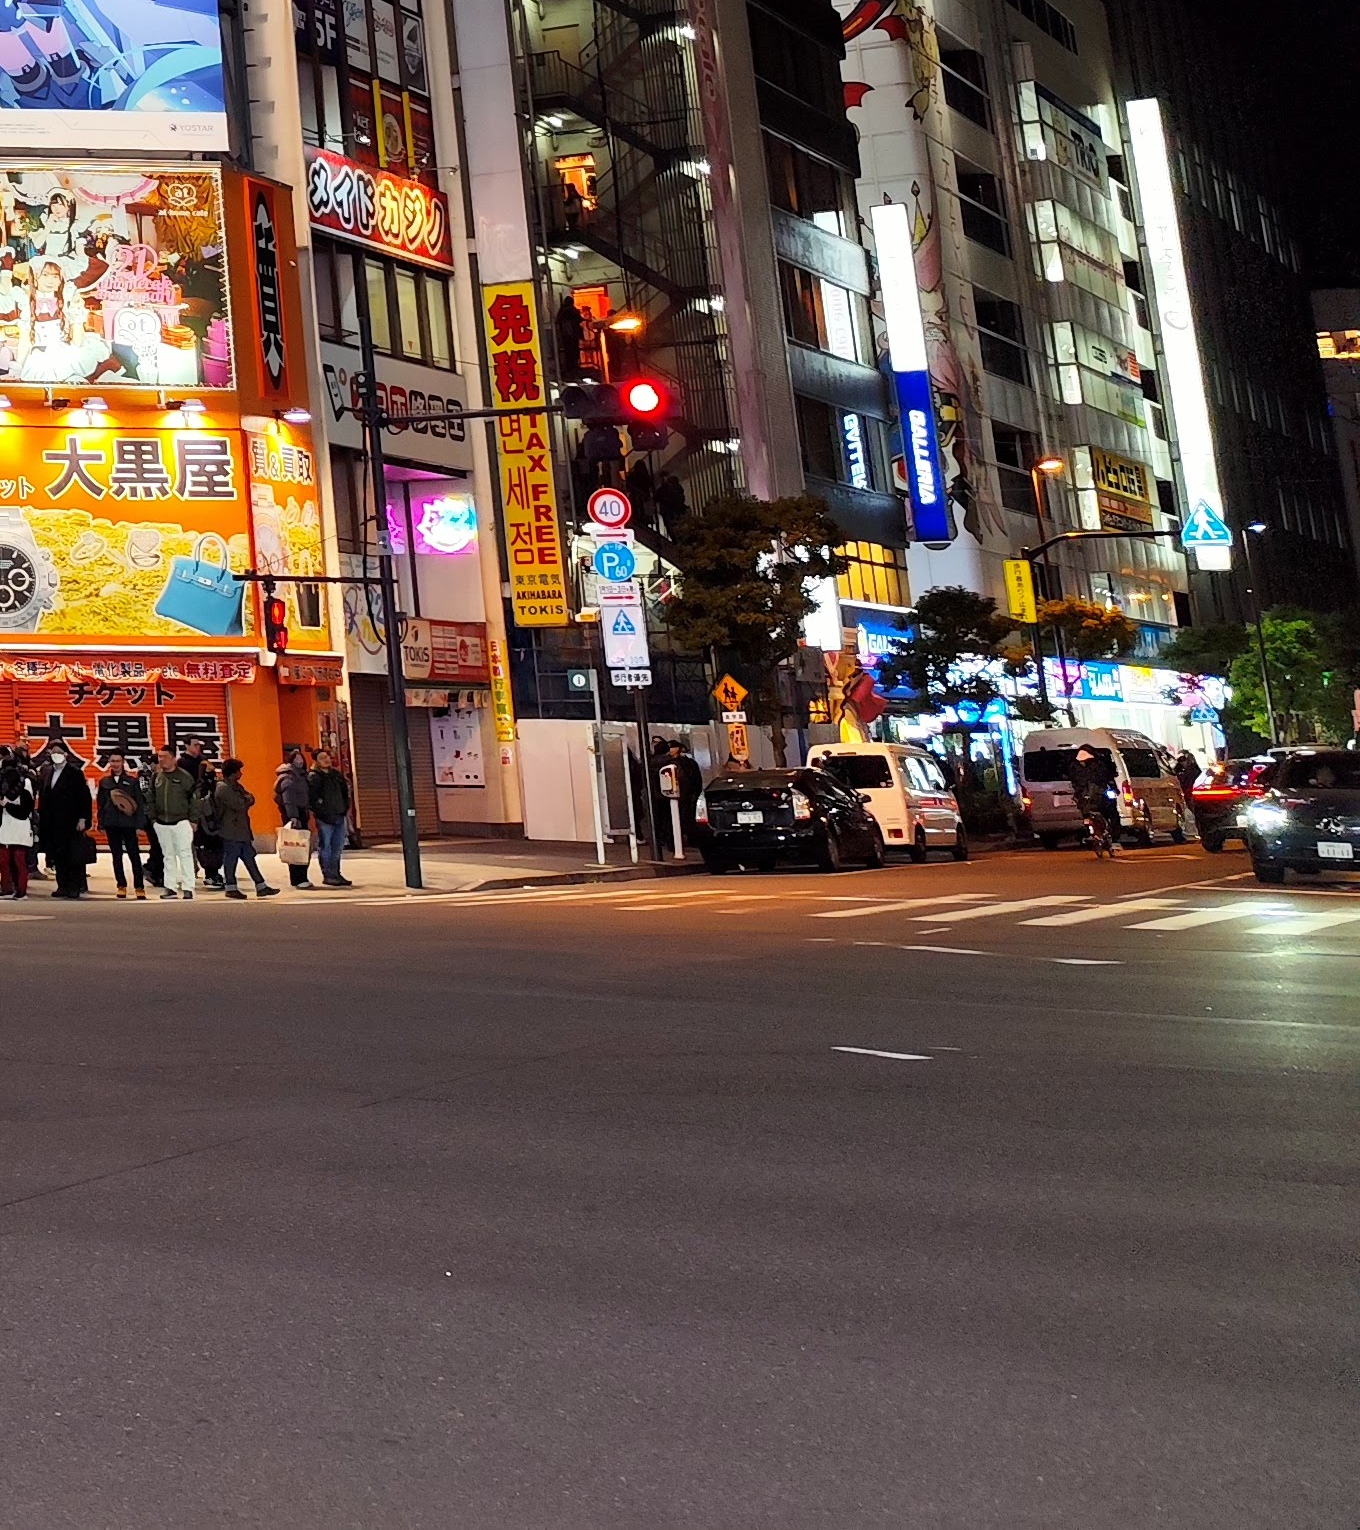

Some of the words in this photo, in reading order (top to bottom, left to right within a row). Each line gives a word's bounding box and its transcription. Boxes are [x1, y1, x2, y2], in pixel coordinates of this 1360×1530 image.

[309, 154, 445, 256] メイドカジノ
[488, 292, 540, 404] 免税
[41, 436, 238, 502] 大黒屋
[498, 411, 536, 566] 면세점
[908, 408, 937, 506] GALLERIA
[531, 483, 558, 566] FREE
[598, 500, 621, 517] 40
[515, 589, 563, 601] AKIHABARA
[601, 552, 619, 578] P
[67, 681, 176, 707] チケット
[185, 660, 253, 680] 無料査定
